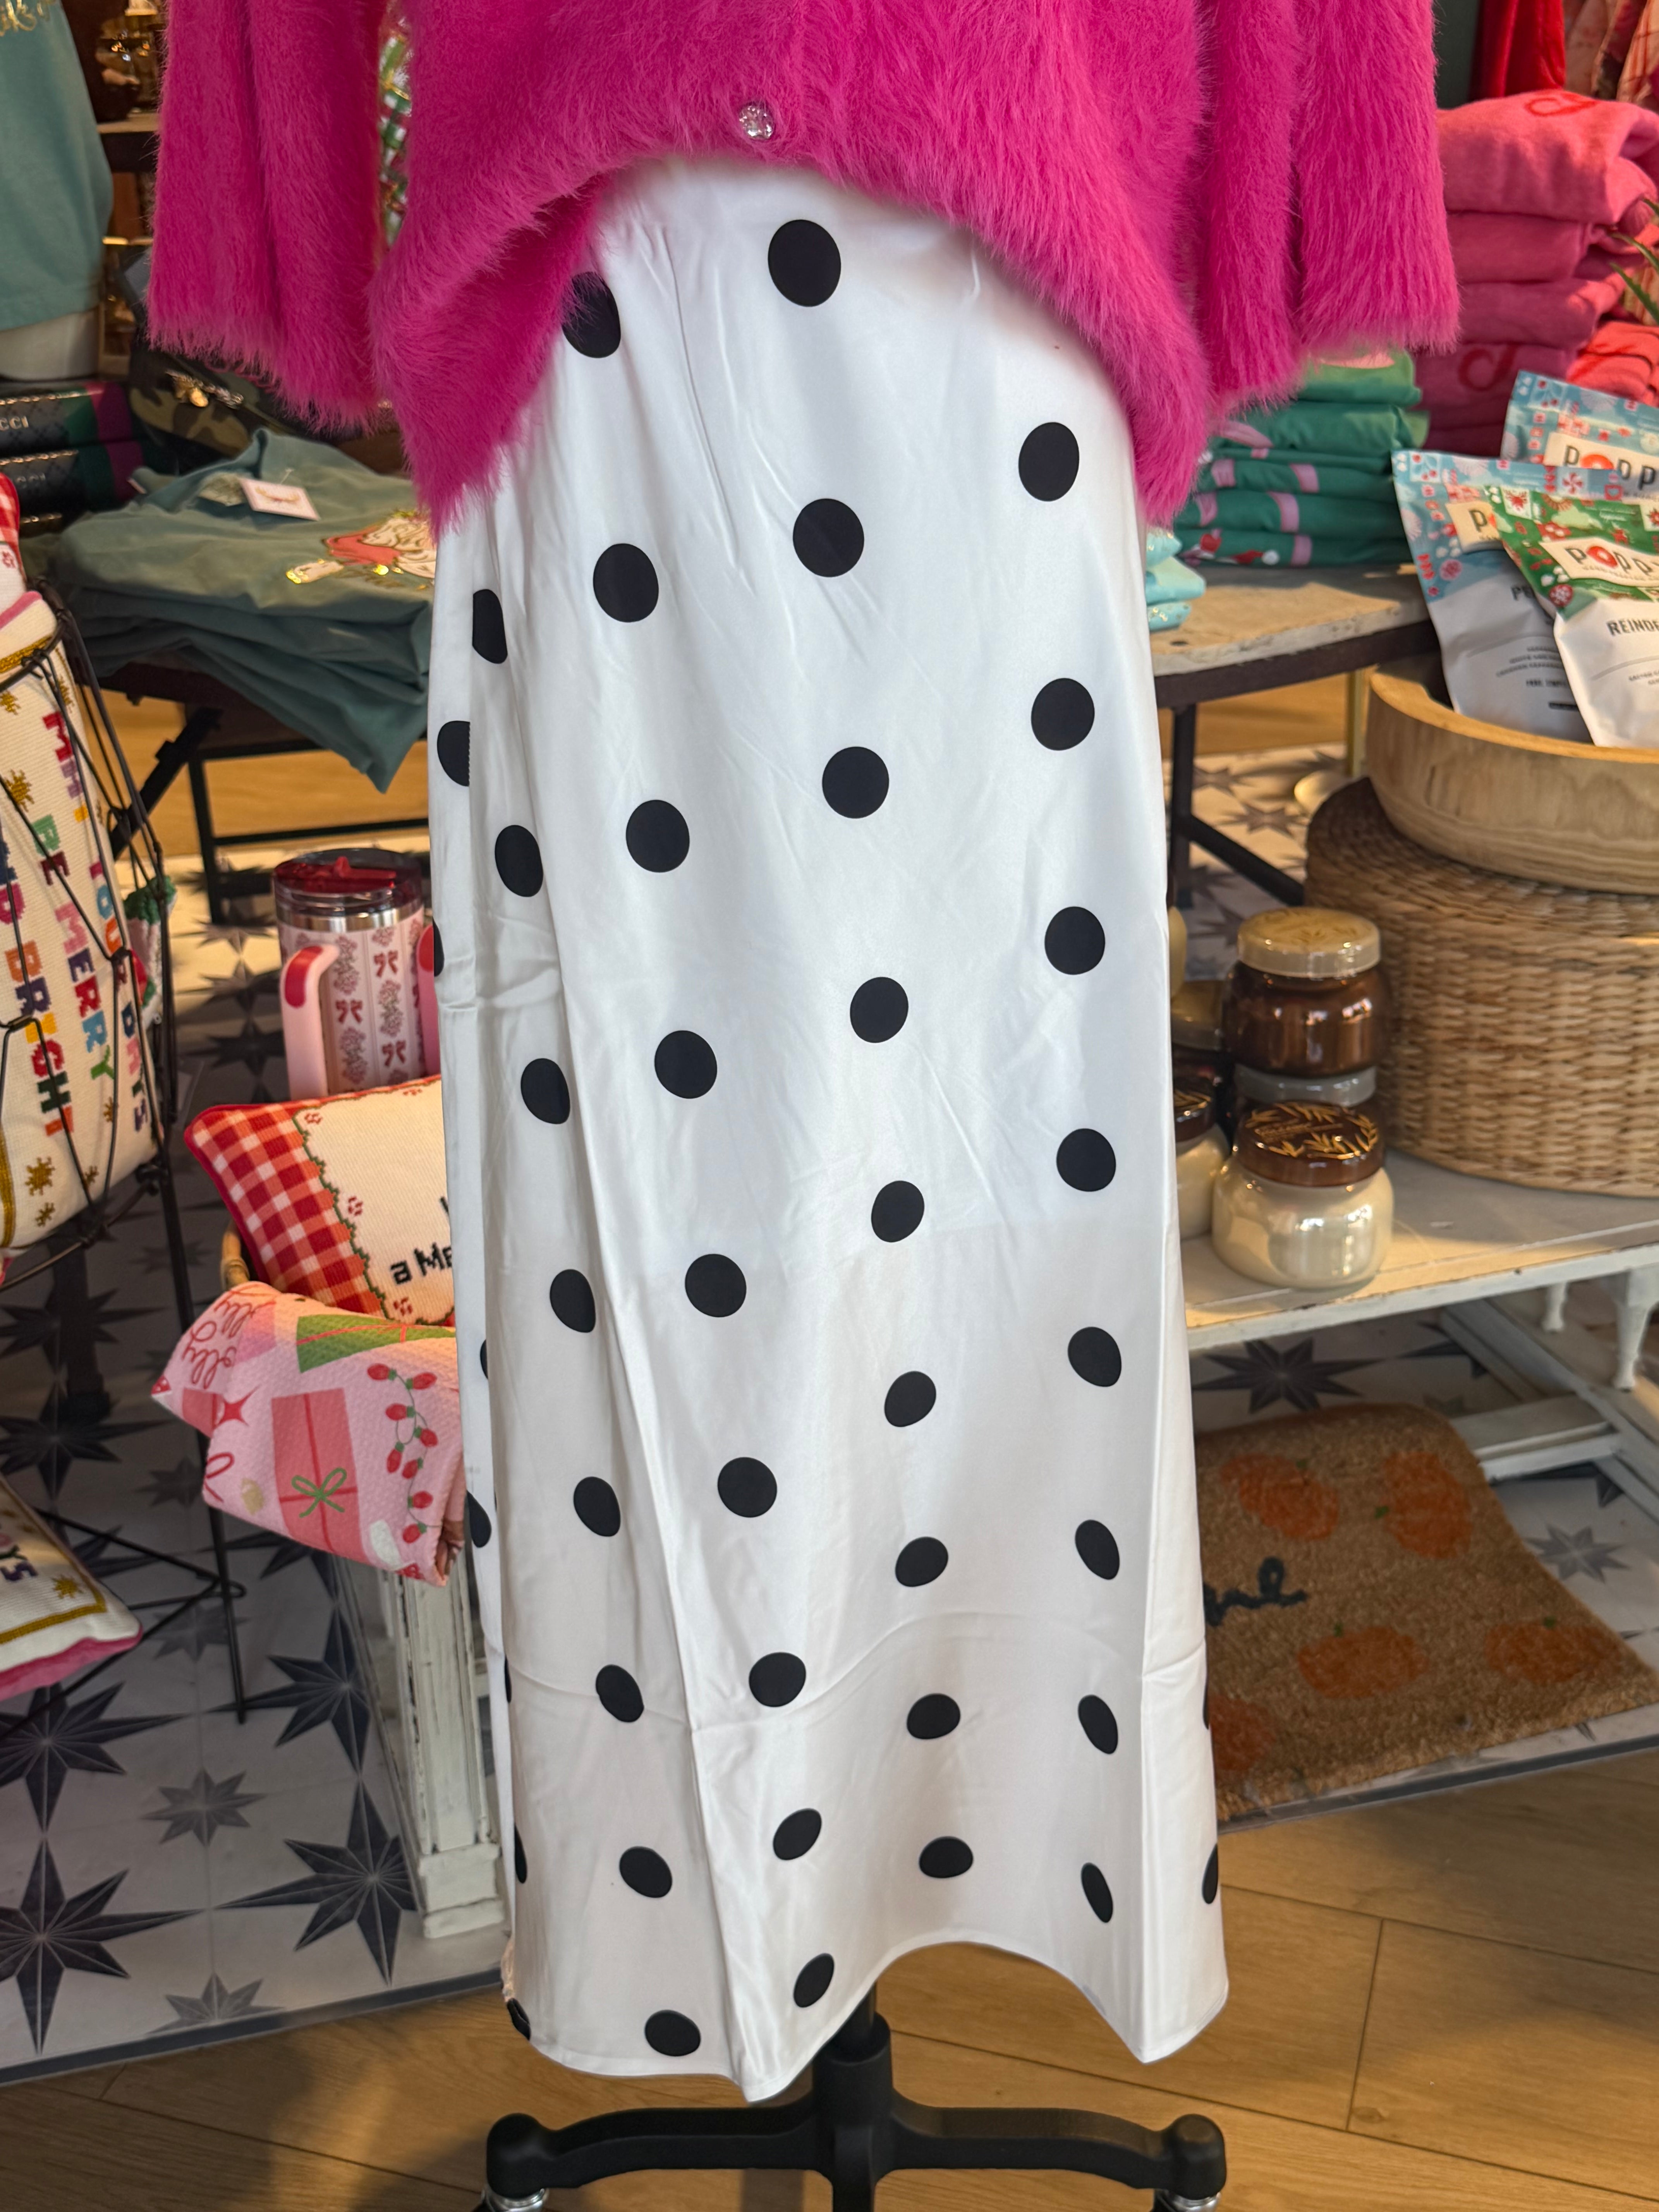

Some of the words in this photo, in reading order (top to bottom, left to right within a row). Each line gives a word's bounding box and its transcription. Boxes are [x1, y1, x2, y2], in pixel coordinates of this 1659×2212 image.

[5, 939, 74, 1137] BRIGHT
[31, 814, 70, 886] BE
[54, 902, 115, 1080] MERRY
[390, 1260, 412, 1285] a
